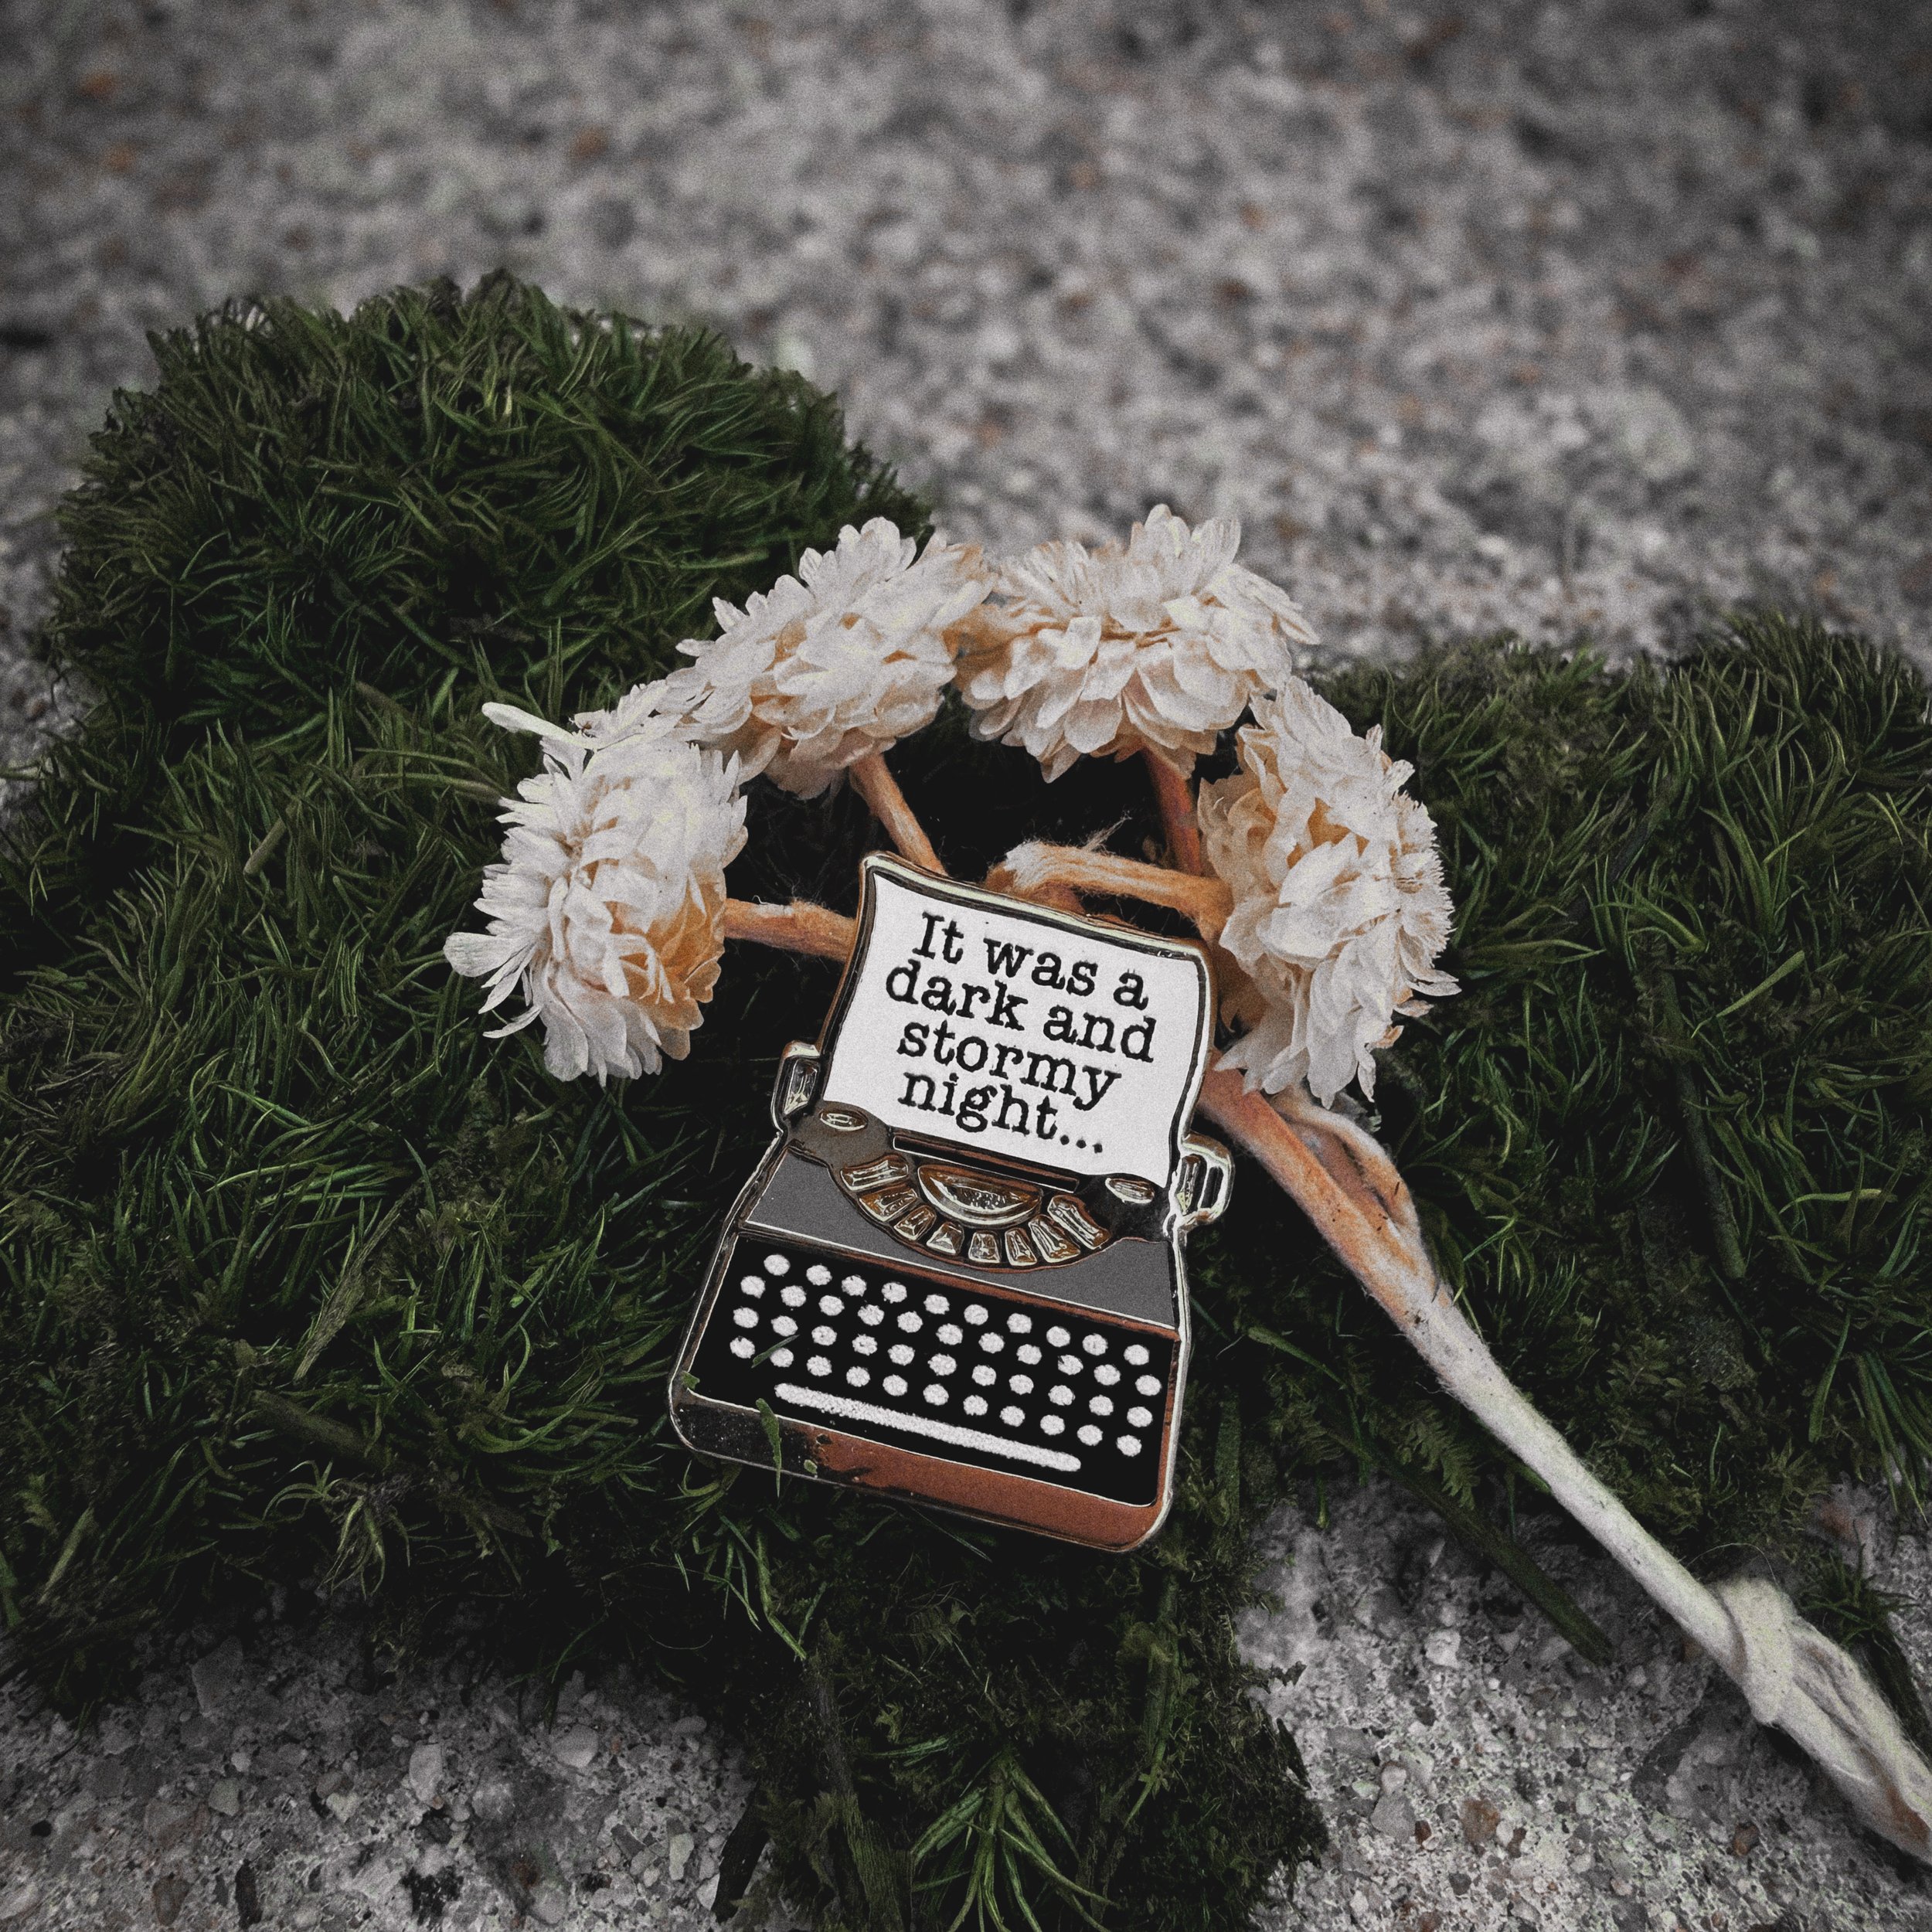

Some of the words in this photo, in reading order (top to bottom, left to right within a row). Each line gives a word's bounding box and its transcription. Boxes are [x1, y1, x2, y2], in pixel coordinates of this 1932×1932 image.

[912, 911, 964, 965] It
[983, 937, 1099, 997] was
[1113, 969, 1149, 1011] a
[886, 958, 1029, 1032] dark
[1043, 1004, 1157, 1063] and
[896, 1019, 1122, 1111] stormy
[897, 1072, 1103, 1154] night...
